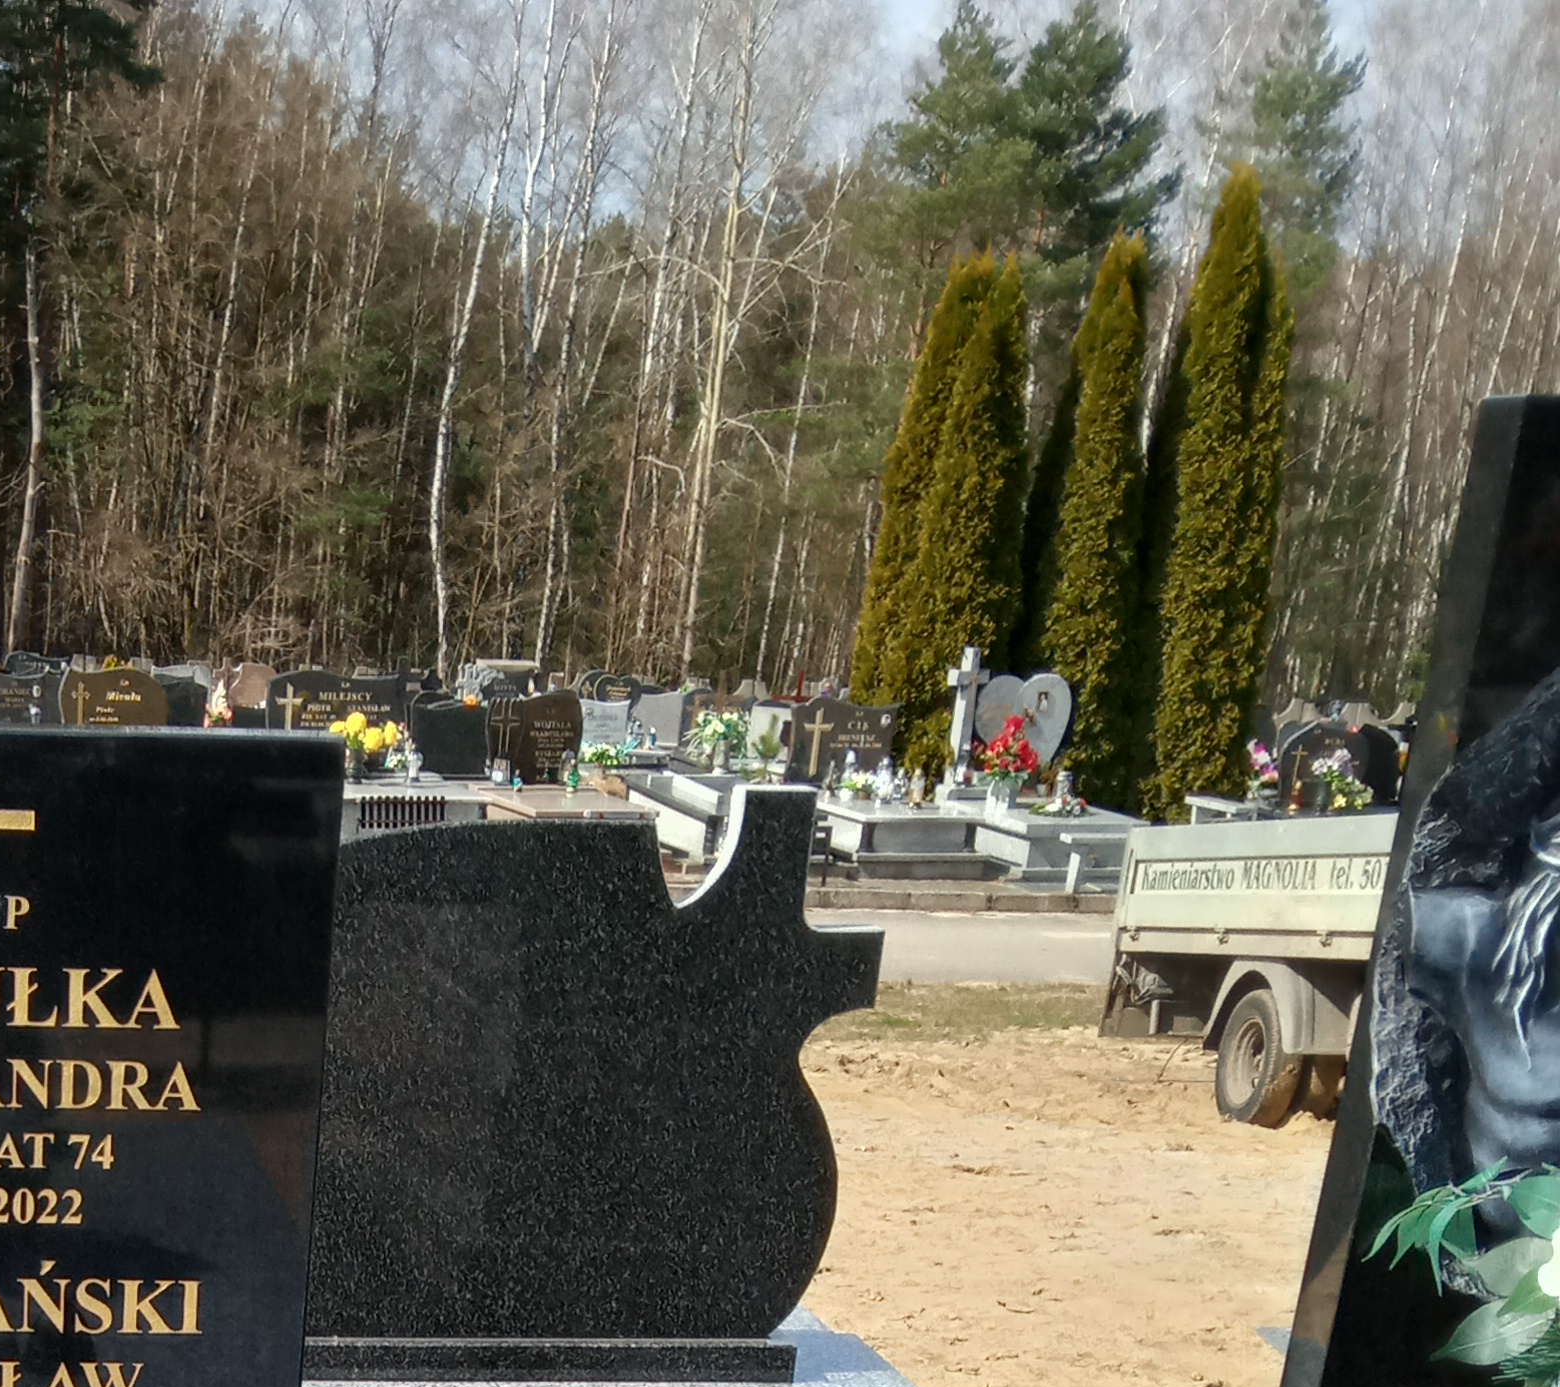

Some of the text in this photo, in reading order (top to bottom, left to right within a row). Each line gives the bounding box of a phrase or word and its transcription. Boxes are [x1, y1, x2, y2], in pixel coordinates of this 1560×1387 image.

[319, 691, 373, 702] MILEJSCY
[1141, 860, 1236, 891] Kamieniarstwo
[1240, 858, 1318, 891] MAGNOLIA
[1329, 857, 1354, 890] tel.
[4, 893, 31, 930] P
[67, 1133, 115, 1170] 74
